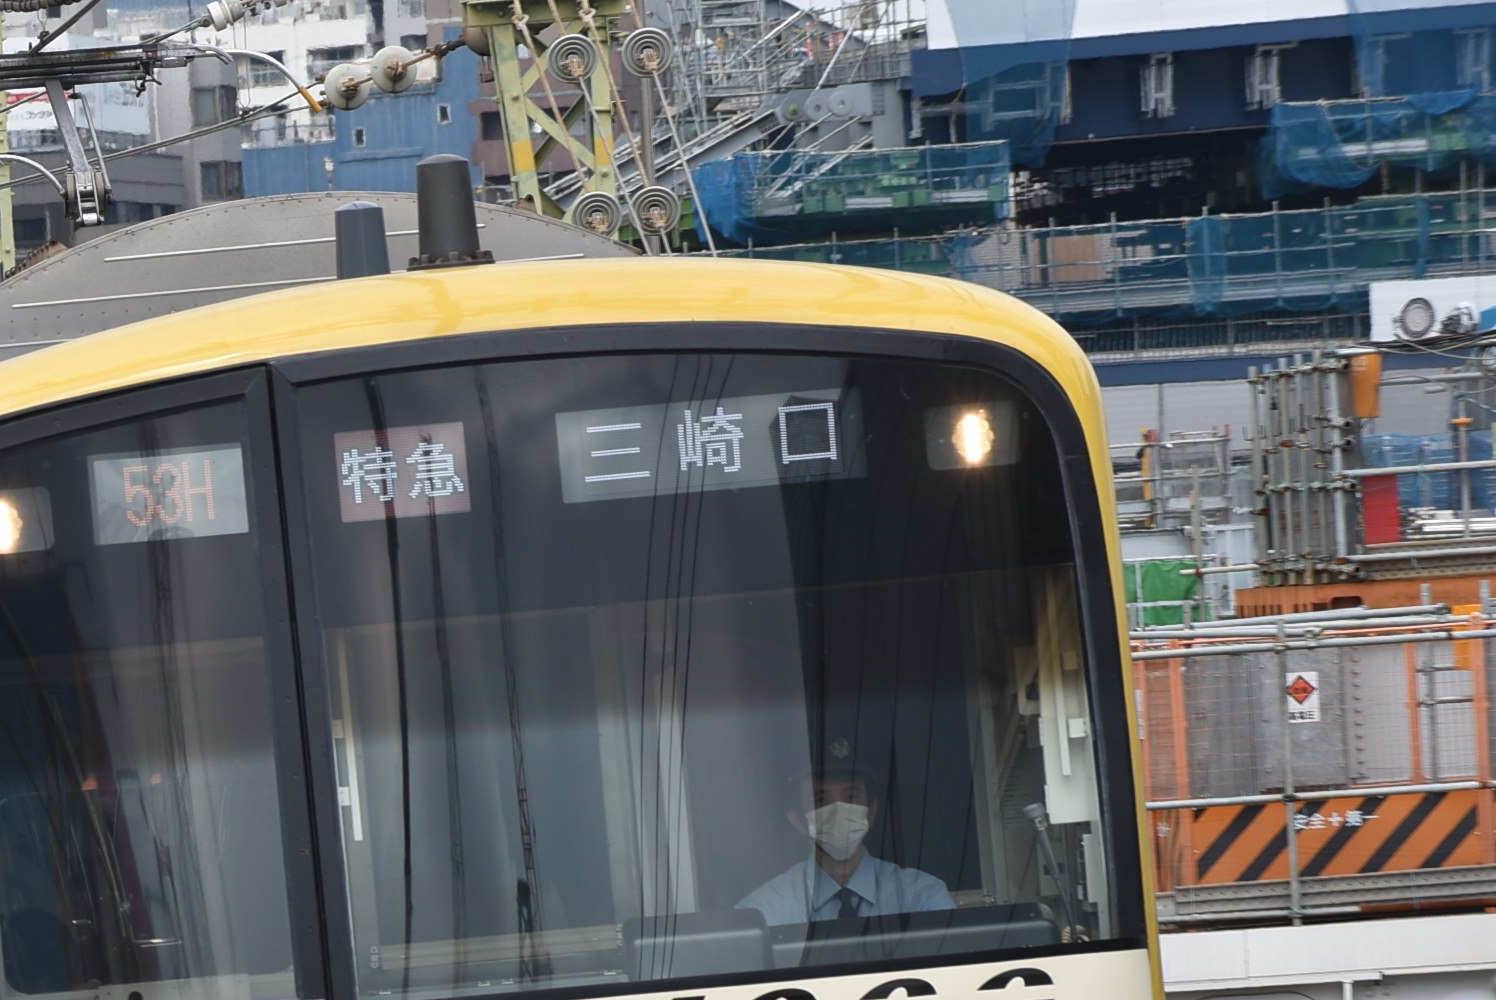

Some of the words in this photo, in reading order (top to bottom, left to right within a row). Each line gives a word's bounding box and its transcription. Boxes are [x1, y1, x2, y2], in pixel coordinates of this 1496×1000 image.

[341, 442, 465, 504] 特急
[584, 402, 838, 483] 三崎口
[121, 459, 216, 527] 53H
